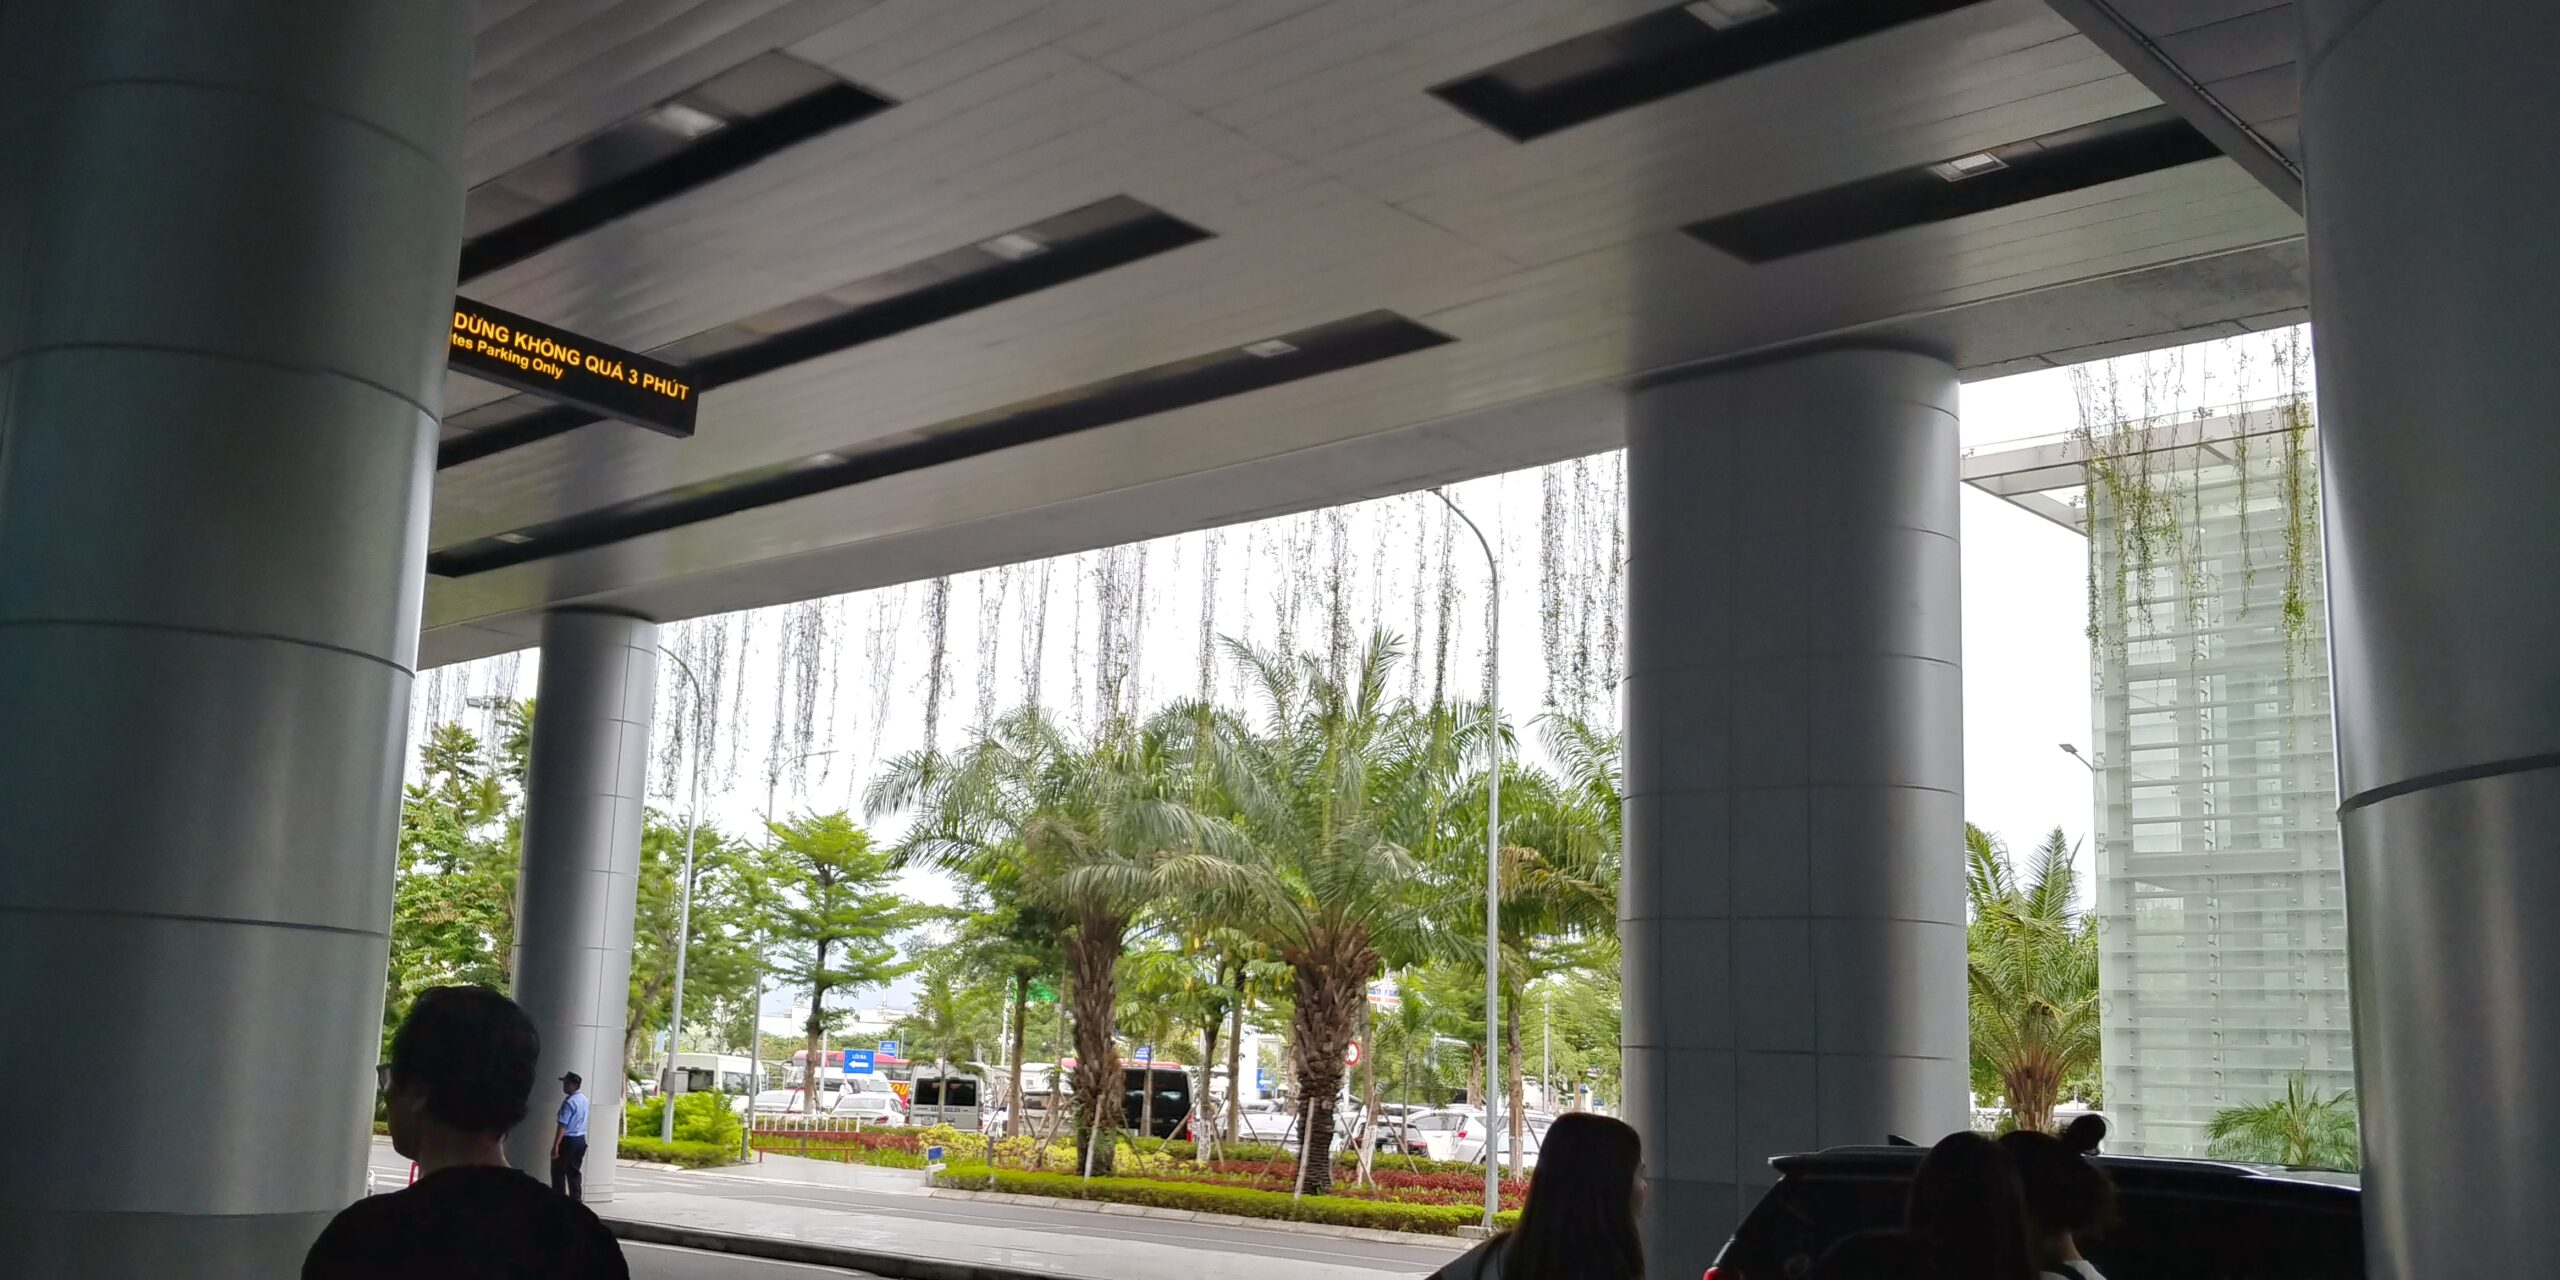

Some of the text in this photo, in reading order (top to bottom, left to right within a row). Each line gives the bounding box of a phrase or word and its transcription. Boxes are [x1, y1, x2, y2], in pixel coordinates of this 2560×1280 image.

[452, 332, 564, 380] tes Parking Only
[454, 311, 690, 401] DỪNG KHÔNG QUÁ 3 PHÚT
